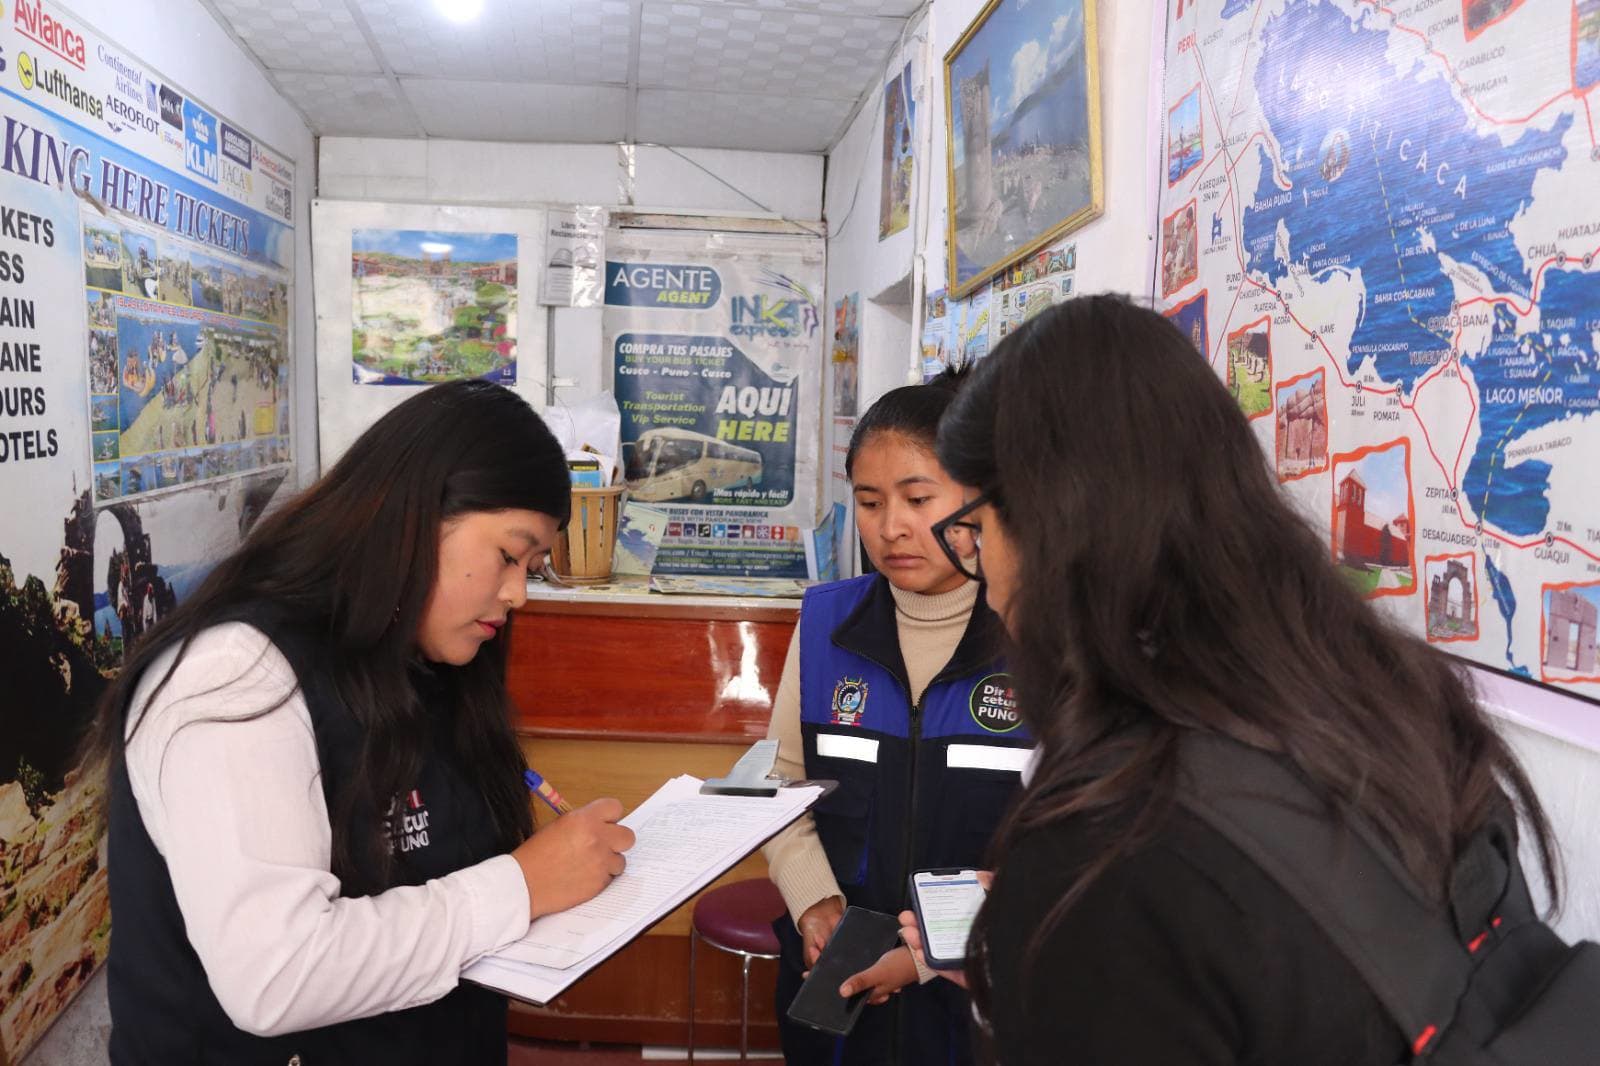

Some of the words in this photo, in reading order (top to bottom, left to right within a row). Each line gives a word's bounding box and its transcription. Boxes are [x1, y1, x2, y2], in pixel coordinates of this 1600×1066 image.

[14, 0, 86, 65] Avianca
[97, 44, 143, 85] Continental
[33, 57, 104, 121] Lufthansa
[106, 94, 160, 136] AEROFLOT
[186, 138, 218, 182] KLM
[1, 115, 92, 198] KING
[100, 159, 169, 228] HERE
[174, 190, 250, 258] TICKETS
[1272, 192, 1293, 207] PUNO
[1, 202, 55, 248] KETS
[1528, 243, 1557, 260] CHUA
[613, 267, 713, 290] AGENTE
[656, 290, 711, 305] AGENT
[1427, 314, 1489, 330] COPACABANA
[0, 342, 42, 372] ANE
[619, 343, 664, 355] COMPRA
[667, 345, 688, 356] TUS
[689, 345, 734, 358] PASAJES
[625, 355, 644, 363] BUY
[646, 356, 671, 365] YOUR
[695, 358, 727, 367] TICKET
[619, 366, 650, 376] Cusco
[660, 367, 690, 378] Puno
[701, 369, 732, 379] Cusco
[0, 387, 46, 417] URS
[645, 391, 684, 401] Tourist
[1351, 395, 1366, 407] JULI
[1485, 387, 1516, 404] LAGO
[1518, 388, 1564, 405] MENOR
[623, 401, 706, 414] Transportation
[1373, 411, 1400, 421] POMATA
[632, 414, 649, 425] Vip
[652, 415, 697, 426] Service
[716, 420, 790, 442] HERE
[1425, 487, 1450, 499] ZEPITA
[1422, 528, 1477, 547] DESAGUADERO
[1534, 547, 1569, 564] GUAQUI
[983, 684, 1004, 696] Dir
[978, 706, 1018, 722] PUNO
[400, 830, 430, 852] UNO
